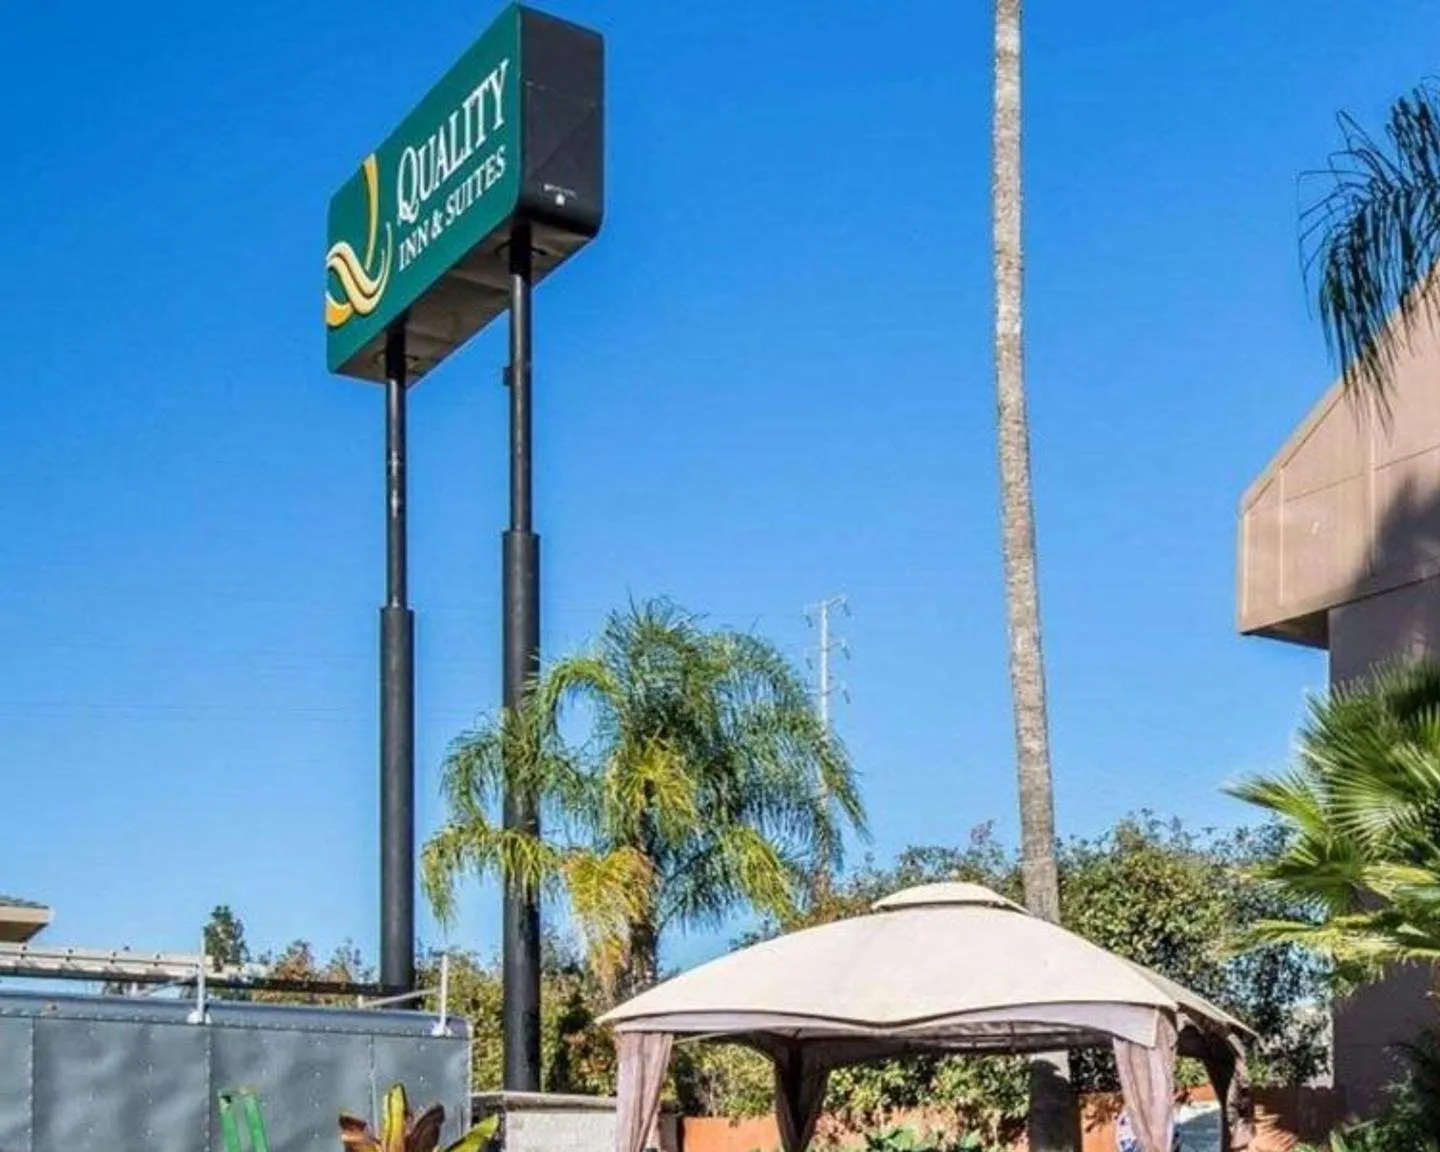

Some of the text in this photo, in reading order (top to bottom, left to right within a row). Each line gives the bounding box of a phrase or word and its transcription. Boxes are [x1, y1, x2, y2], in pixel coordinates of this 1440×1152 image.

[396, 58, 510, 226] QUALITY
[399, 144, 507, 272] INN & SUITES
